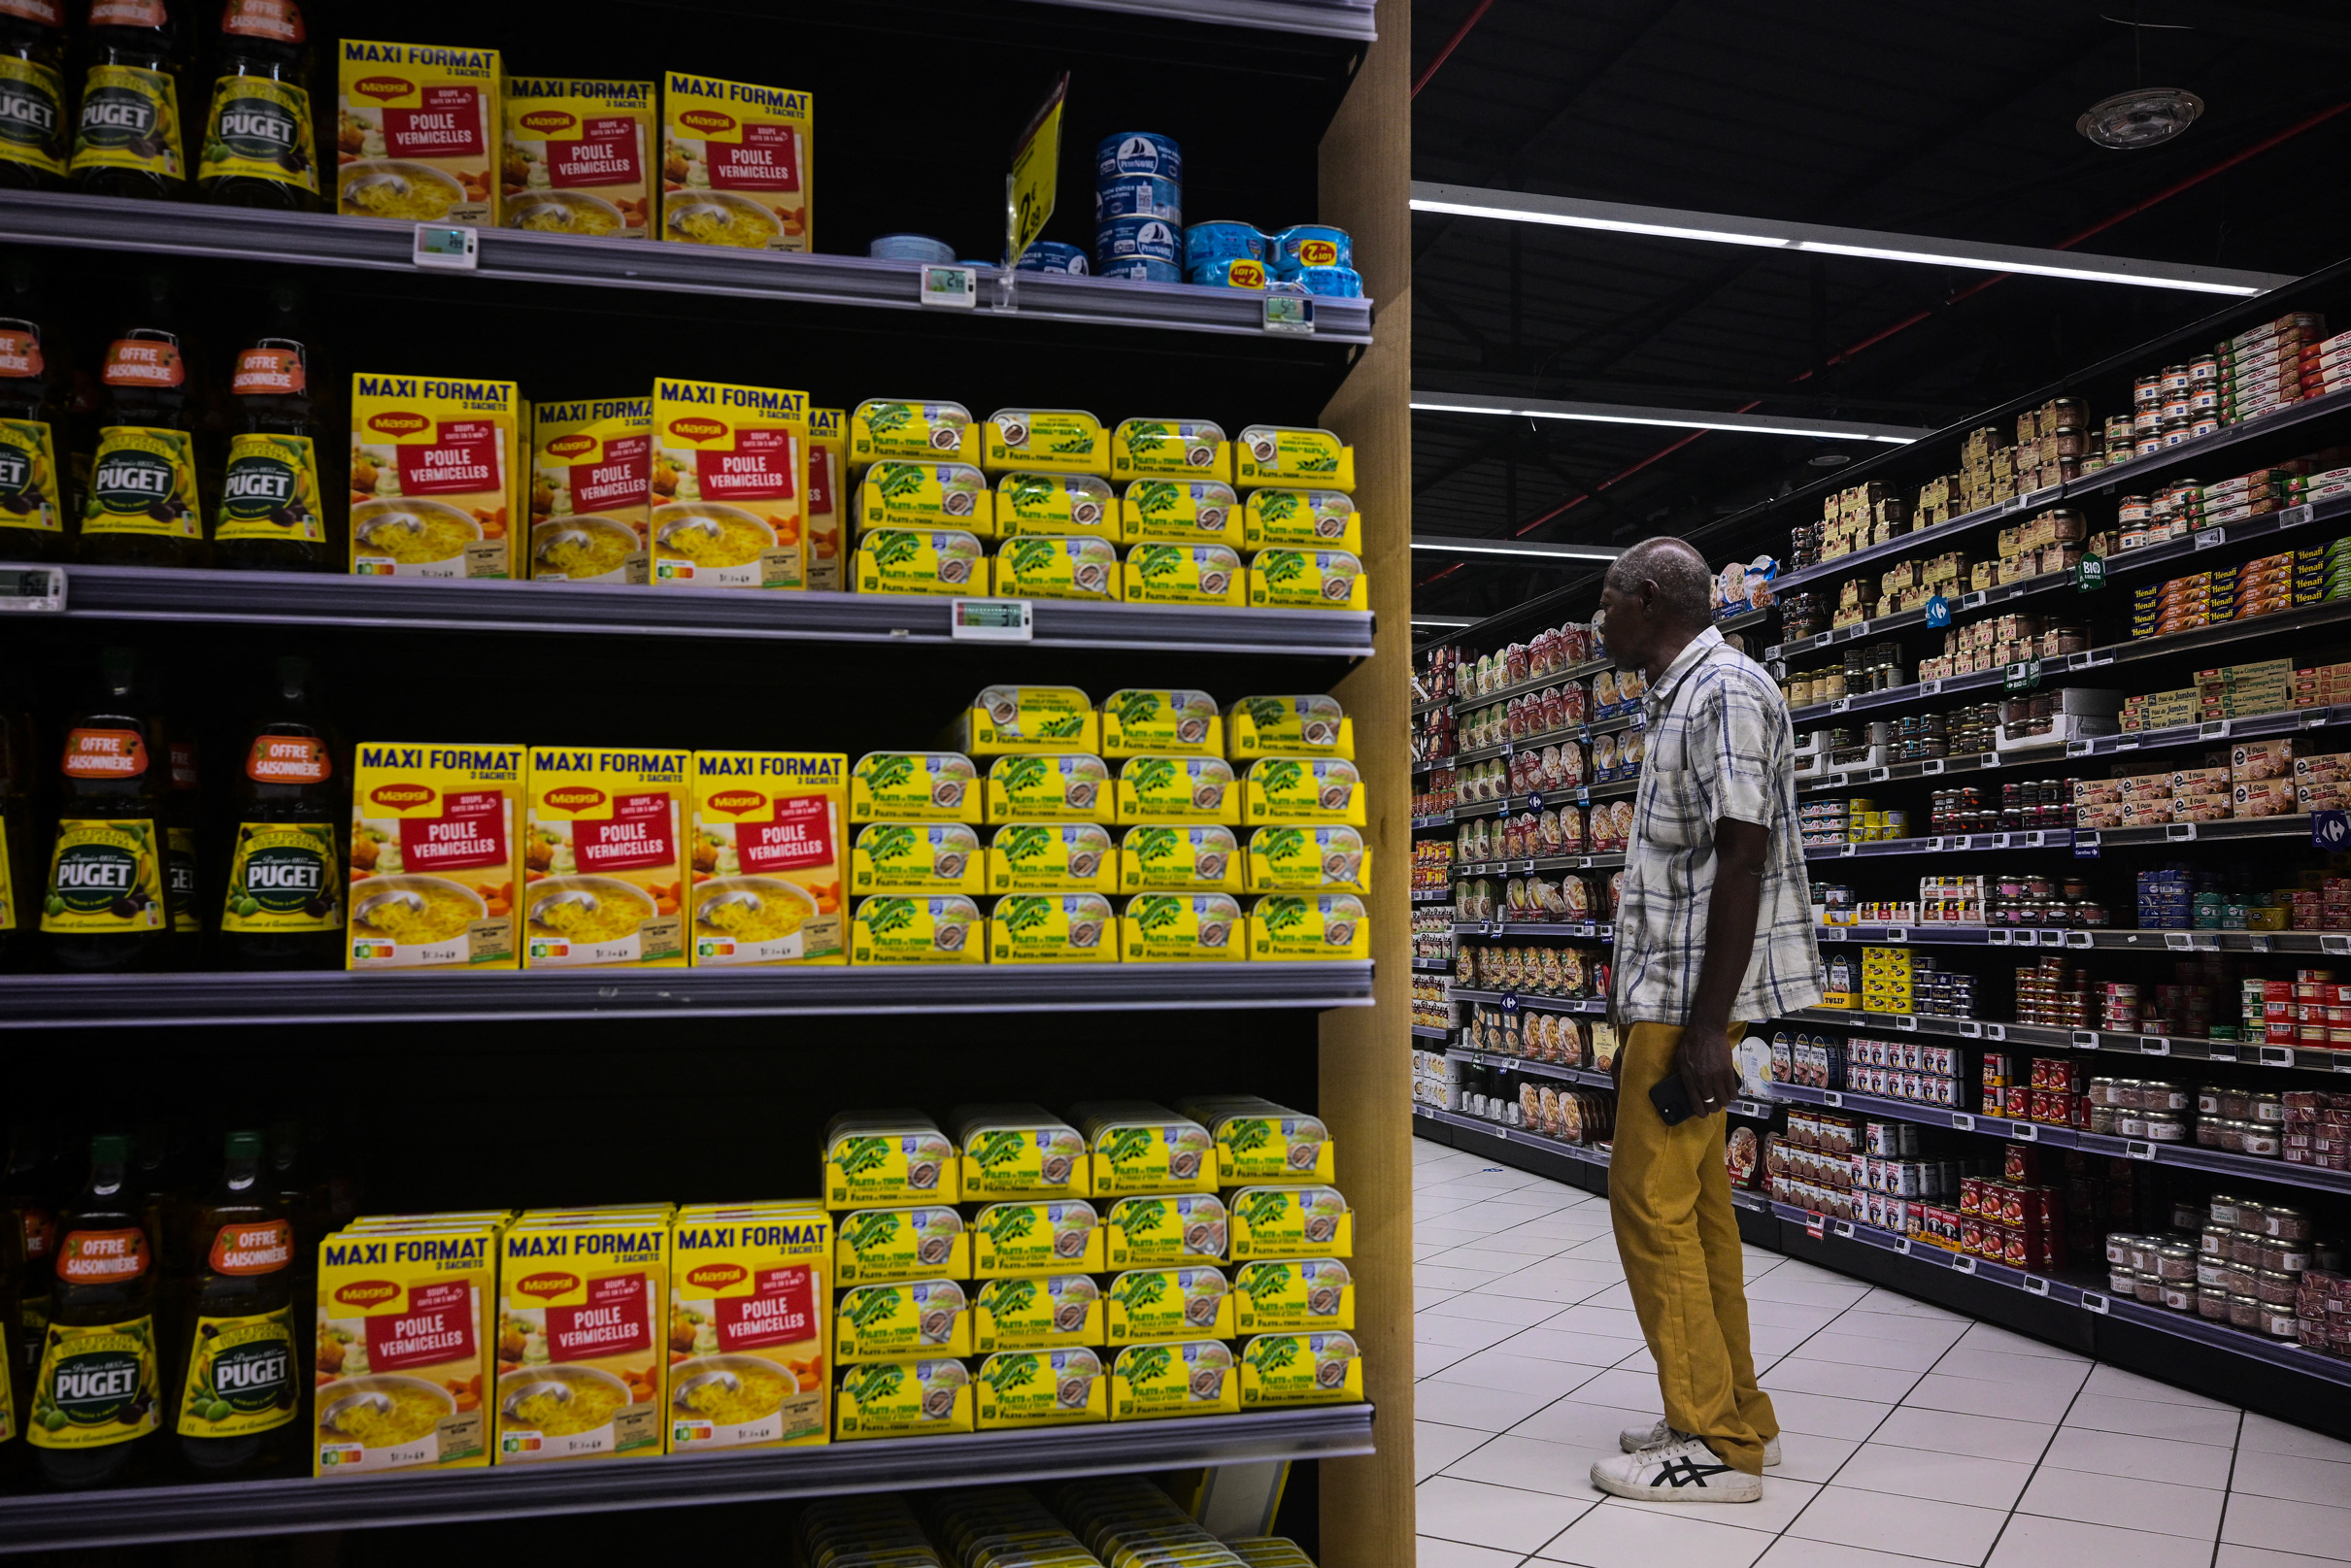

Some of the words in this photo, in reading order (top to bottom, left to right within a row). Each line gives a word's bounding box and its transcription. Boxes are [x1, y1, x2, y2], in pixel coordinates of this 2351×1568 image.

[347, 43, 401, 63] MAXI
[410, 48, 493, 68] FORMAT
[361, 82, 409, 94] Maggi
[513, 81, 563, 97] MAXI
[571, 83, 650, 99] FORMAT
[672, 77, 723, 99] MAXI
[731, 84, 808, 110] FORMAT
[82, 104, 150, 128] PUGET
[410, 114, 455, 131] POULE
[526, 117, 571, 127] Maggi
[686, 114, 730, 129] Maggi
[220, 115, 294, 143] PUGET
[395, 129, 472, 145] VERMICELLES
[571, 144, 614, 162] POULE
[731, 150, 773, 165] POULE
[558, 158, 630, 176] VERMICELLES
[718, 165, 789, 179] VERMICELLES
[1249, 269, 1259, 284] 2
[119, 348, 157, 361] OFFRE
[244, 355, 278, 370] OFFRE
[107, 364, 171, 381] SAISONNIÈRE
[233, 372, 291, 387] SAISONNIÈRE
[360, 378, 417, 397] MAXI
[424, 382, 511, 401] FORMAT
[661, 383, 715, 404] MAXI
[723, 388, 804, 412] FORMAT
[540, 403, 587, 423] MAXI
[593, 400, 652, 419] FORMA
[375, 417, 423, 429] Maggi
[676, 421, 722, 436] Maggi
[552, 439, 592, 453] Maggi
[424, 449, 471, 468] POULE
[722, 456, 766, 474] POULE
[96, 466, 169, 492] PUGET
[410, 465, 488, 483] VERMICELLES
[592, 464, 631, 486] POULE
[709, 473, 783, 487] VERMICELLES
[225, 473, 289, 497] PUGET
[580, 478, 646, 501] VERMICELLES
[2298, 547, 2324, 560] Hénaff
[2082, 561, 2100, 575] BIO
[2214, 567, 2237, 581] Hénaff
[2298, 561, 2324, 574] Hénaff
[2211, 582, 2234, 594] Hénaff
[2296, 576, 2323, 588] Hénaff
[2134, 585, 2157, 599] Hénaff
[2296, 590, 2323, 603] Hénaff
[2134, 599, 2157, 612] Hénaff
[2210, 595, 2233, 608] Hénaff
[2133, 612, 2156, 624] Hénaff
[2210, 609, 2233, 621] Hénaff
[2132, 625, 2154, 637] Hénaff
[2174, 690, 2197, 701] Jambon
[2166, 704, 2188, 715] Jambon
[2166, 717, 2188, 727] Jambon
[81, 737, 120, 752] OFFRE
[270, 744, 309, 758] OFFRE
[67, 753, 135, 771] SAISONNIÈRE
[255, 760, 321, 777] SAISONNIÈRE
[363, 749, 421, 768] MAXI
[431, 751, 521, 770] FORMAT
[536, 752, 592, 771] MAXI
[601, 754, 687, 773] FORMAT
[699, 757, 754, 775] MAXI
[761, 758, 843, 775] FORMAT
[378, 790, 429, 802] Maggi
[551, 792, 599, 805] Maggi
[714, 795, 760, 808] Maggi
[429, 821, 478, 843] POULE
[600, 822, 647, 844] POULE
[761, 824, 806, 846] POULE
[413, 838, 495, 858] VERMICELLES
[585, 839, 664, 859] VERMICELLES
[748, 840, 823, 860] VERMICELLES
[57, 863, 132, 887] PUGET
[249, 865, 320, 887] PUGET
[239, 1229, 277, 1248] OFFRE
[509, 1236, 566, 1257] MAXI
[575, 1232, 664, 1254] FORMAT
[679, 1228, 734, 1250] MAXI
[743, 1224, 827, 1246] FORMAT
[83, 1238, 125, 1255] OFFRE
[326, 1243, 386, 1266] MAXI
[395, 1238, 487, 1262] FORMAT
[66, 1254, 139, 1275] SAISONNIÈRE
[222, 1245, 287, 1267] SAISONNIÈRE
[524, 1277, 574, 1292] Maggi
[693, 1268, 741, 1284] Maggi
[342, 1284, 394, 1301] Maggi
[742, 1297, 788, 1321] POULE
[394, 1314, 445, 1340] POULE
[574, 1306, 621, 1331] POULE
[727, 1313, 805, 1338] VERMICELLES
[379, 1330, 463, 1357] VERMICELLES
[558, 1321, 639, 1348] VERMICELLES
[217, 1355, 287, 1390] PUGET
[56, 1367, 136, 1399] PUGET
